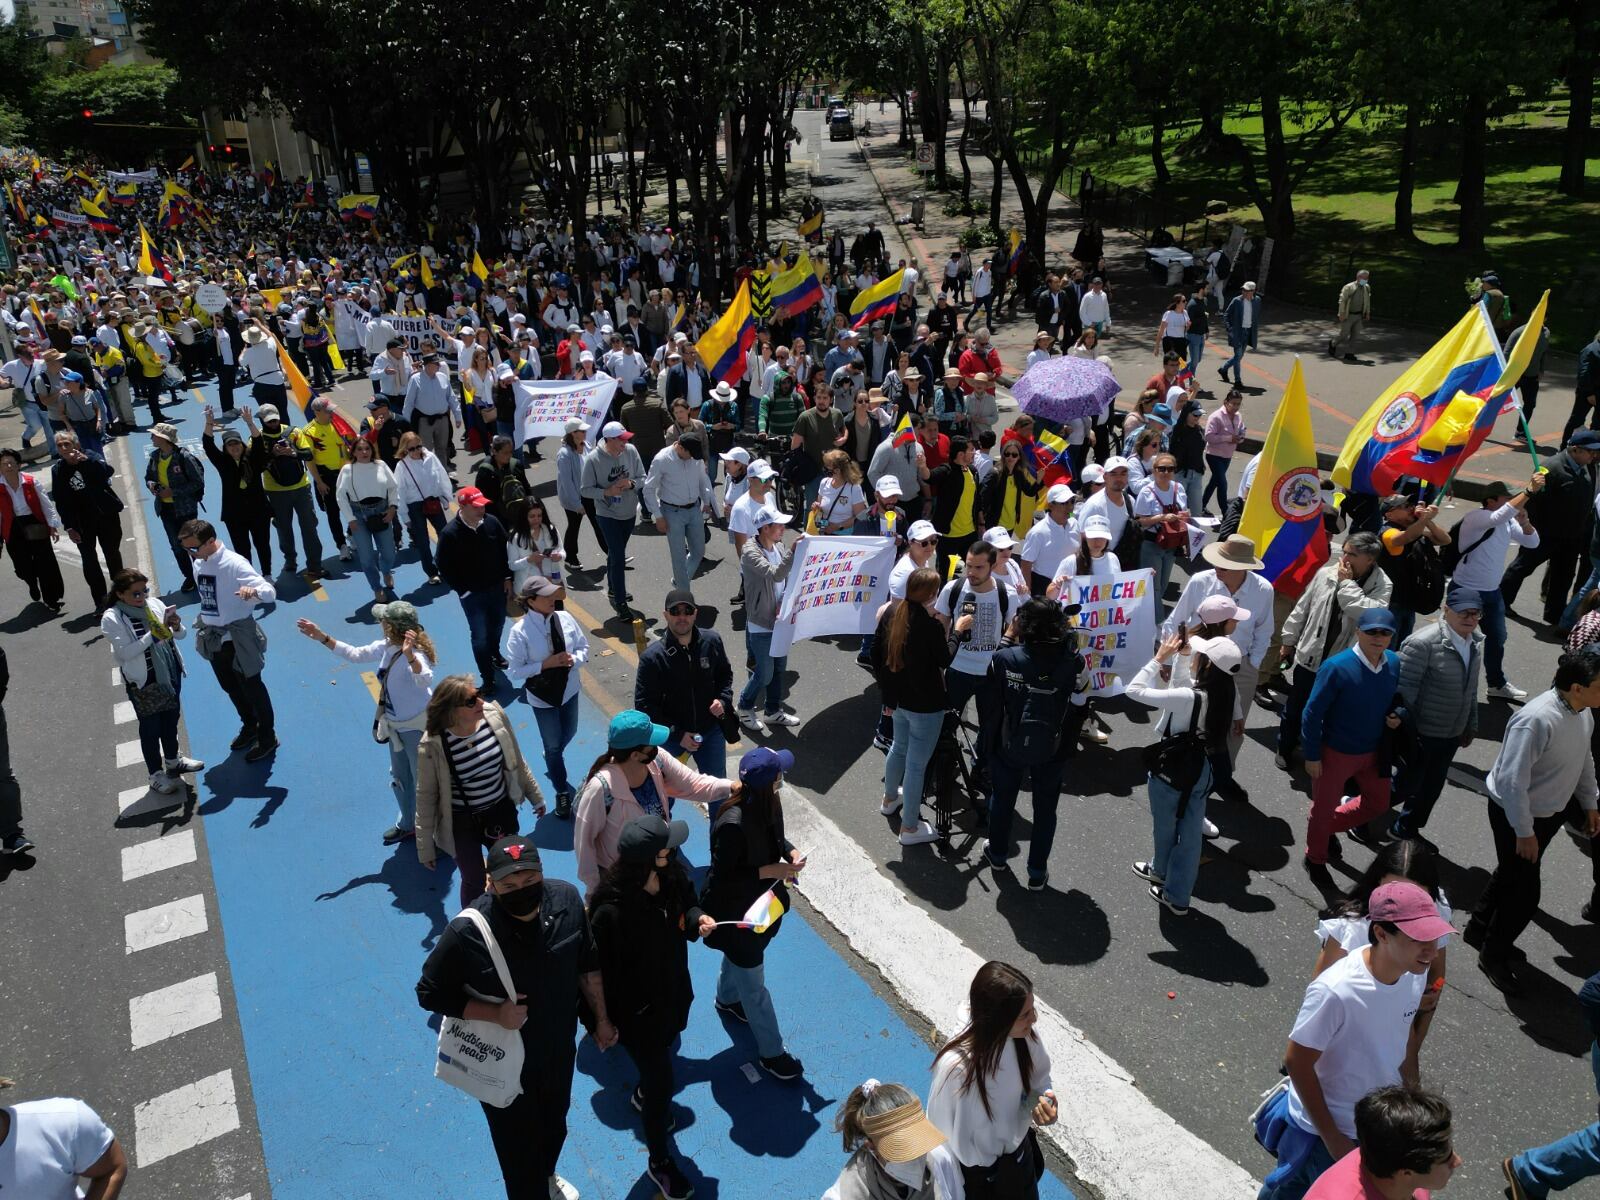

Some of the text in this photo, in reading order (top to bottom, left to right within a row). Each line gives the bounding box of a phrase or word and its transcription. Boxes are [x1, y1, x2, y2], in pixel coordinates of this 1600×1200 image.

[610, 464, 625, 475] NIKE
[846, 574, 878, 588] LIBRE
[812, 590, 872, 608] INSEGURIDAD
[1078, 579, 1146, 605] MARCHA
[980, 642, 997, 652] KLEIN
[1078, 631, 1128, 651] UIERE
[446, 1023, 506, 1062] Mindblowing
[458, 1044, 488, 1063] peace
